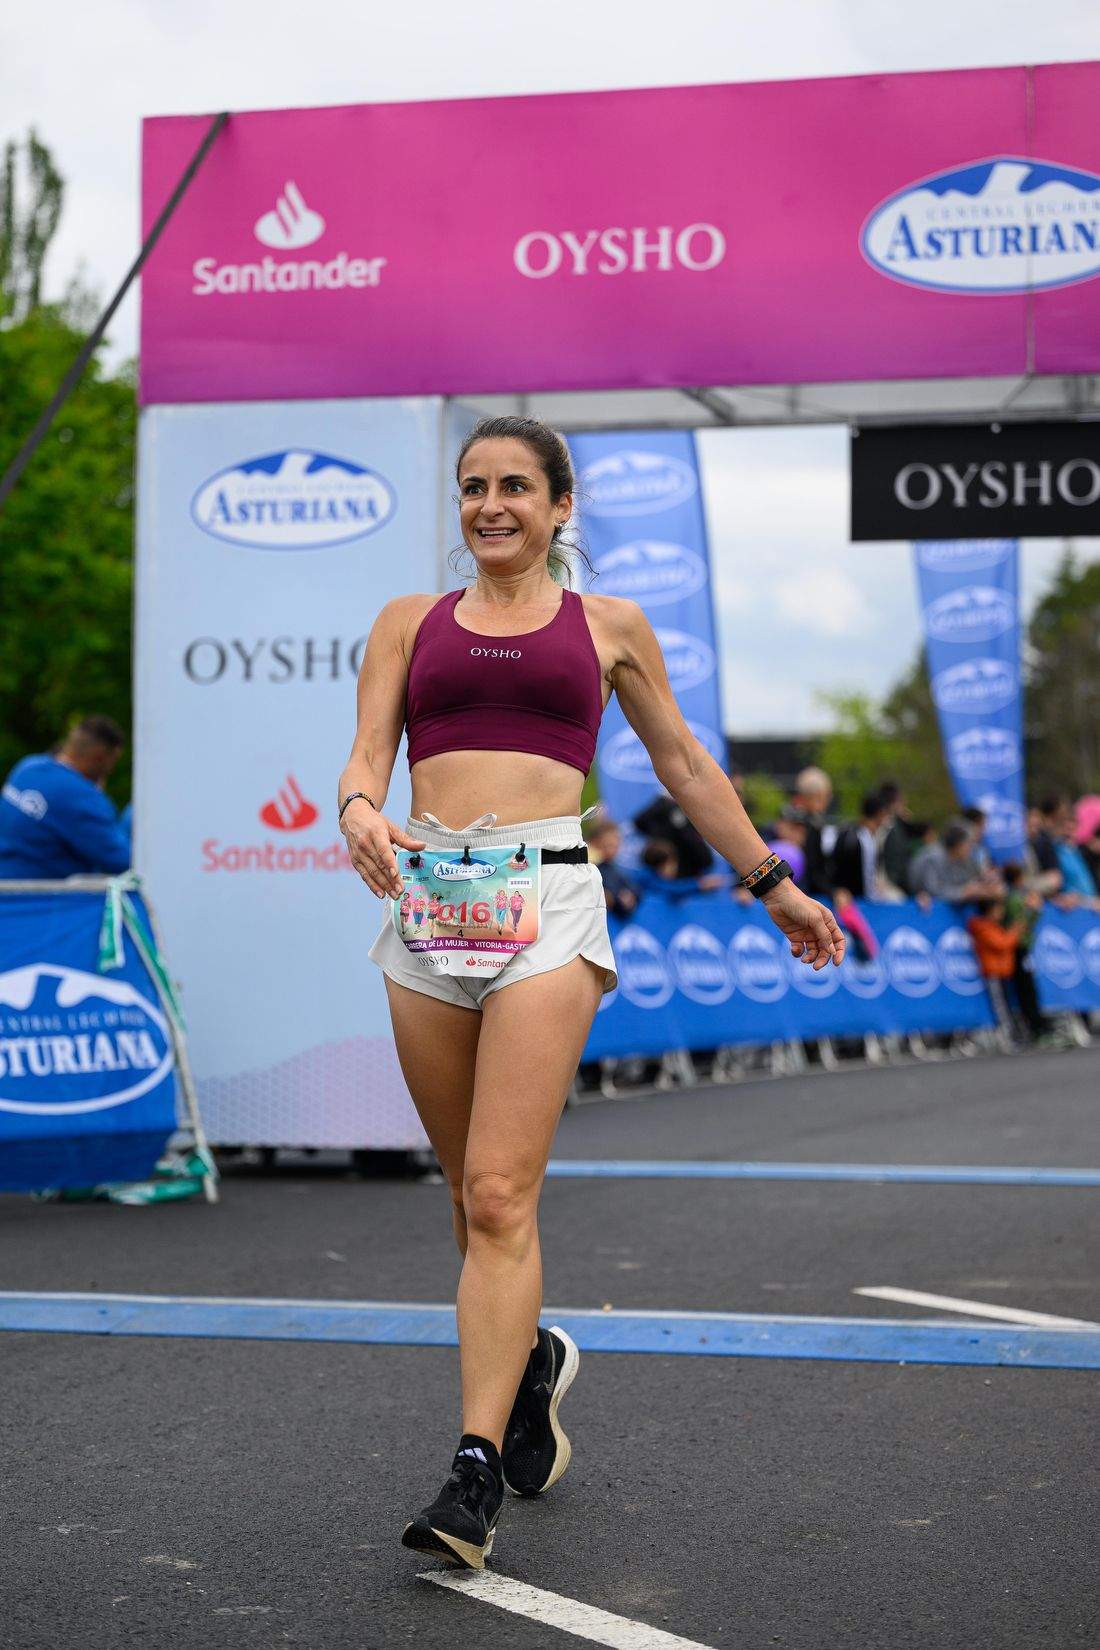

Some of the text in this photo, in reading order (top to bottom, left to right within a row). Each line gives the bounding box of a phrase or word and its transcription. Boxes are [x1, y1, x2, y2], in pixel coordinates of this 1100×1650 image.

[514, 223, 726, 279] OYSHO
[886, 213, 1100, 261] ASTURIAN
[193, 252, 388, 295] Santander
[894, 457, 1100, 510] OYSHO
[208, 488, 379, 527] ASTURIANA
[470, 647, 522, 659] OYSHO
[202, 838, 351, 873] Santand
[445, 939, 469, 947] MUJER
[0, 1029, 161, 1077] TURIANA
